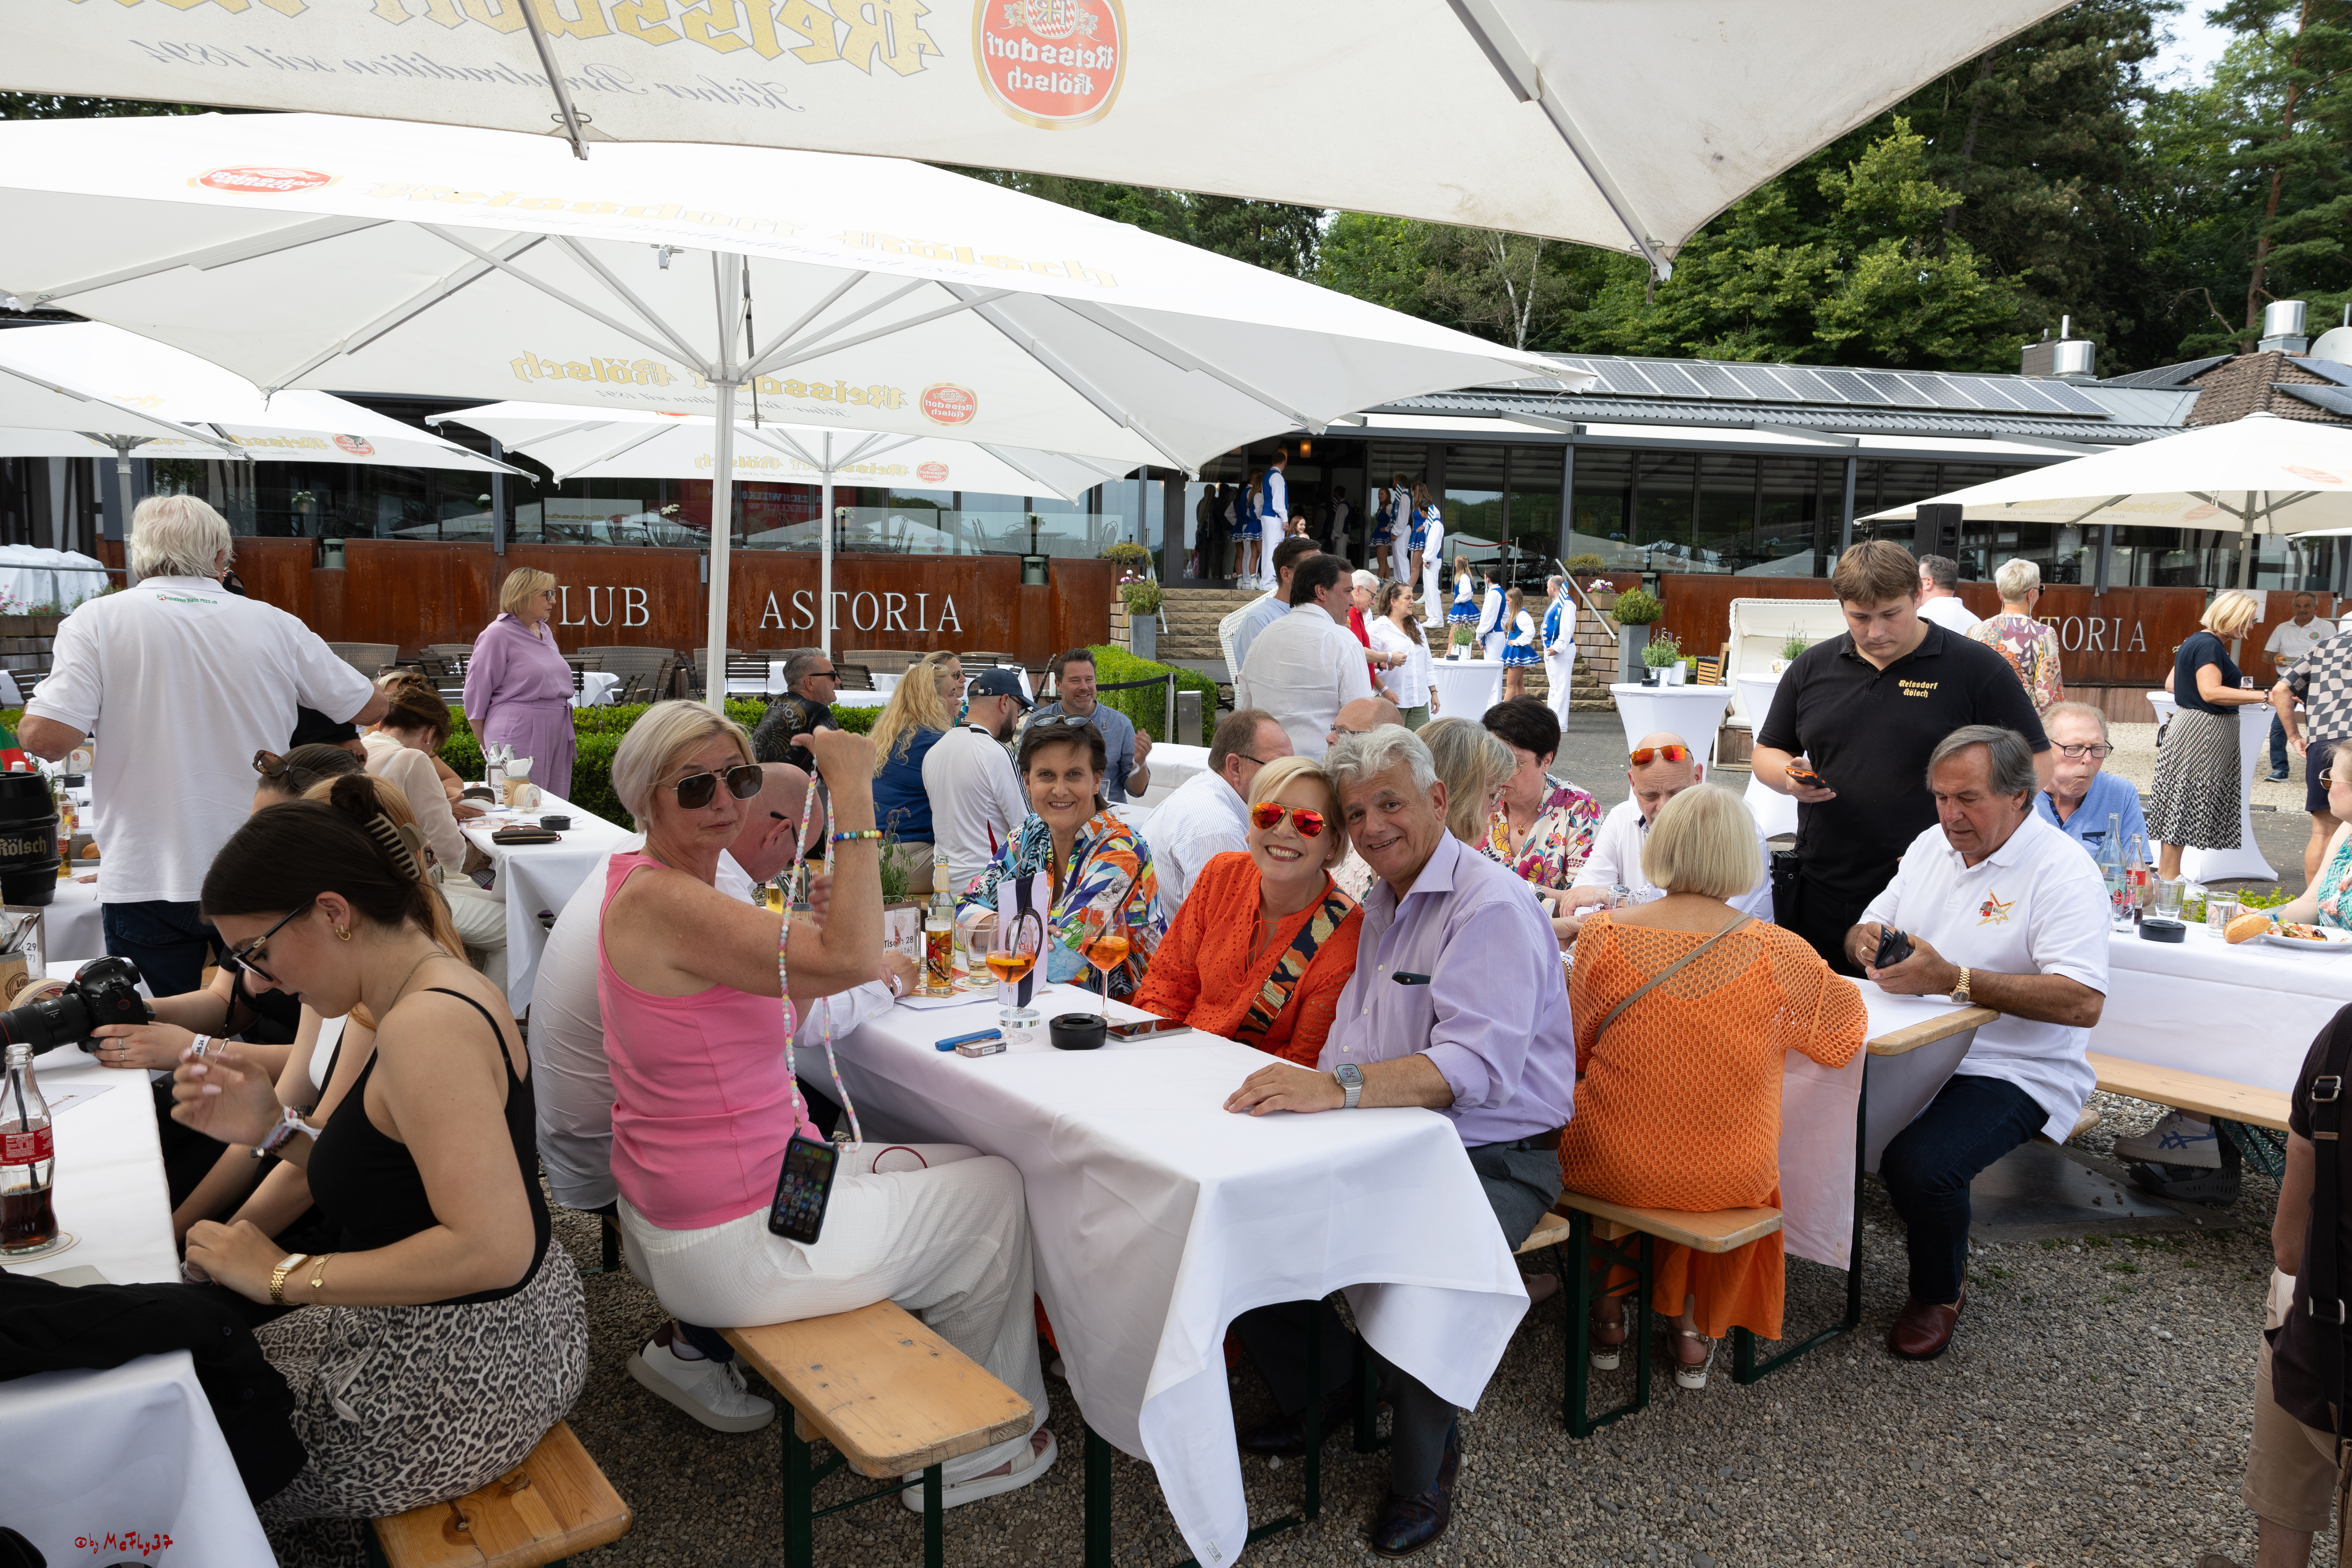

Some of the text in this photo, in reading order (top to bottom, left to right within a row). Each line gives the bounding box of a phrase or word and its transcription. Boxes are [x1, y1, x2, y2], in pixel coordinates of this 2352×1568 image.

[210, 171, 325, 187] Reissdorf
[364, 182, 1118, 288] Reissdorf Kölsch
[544, 586, 962, 632] LUB ASTORIA
[2039, 616, 2147, 652] TORIA
[1898, 680, 1938, 690] Reissdorf
[1903, 688, 1928, 698] Kölsch
[0, 835, 47, 857] Kölsch
